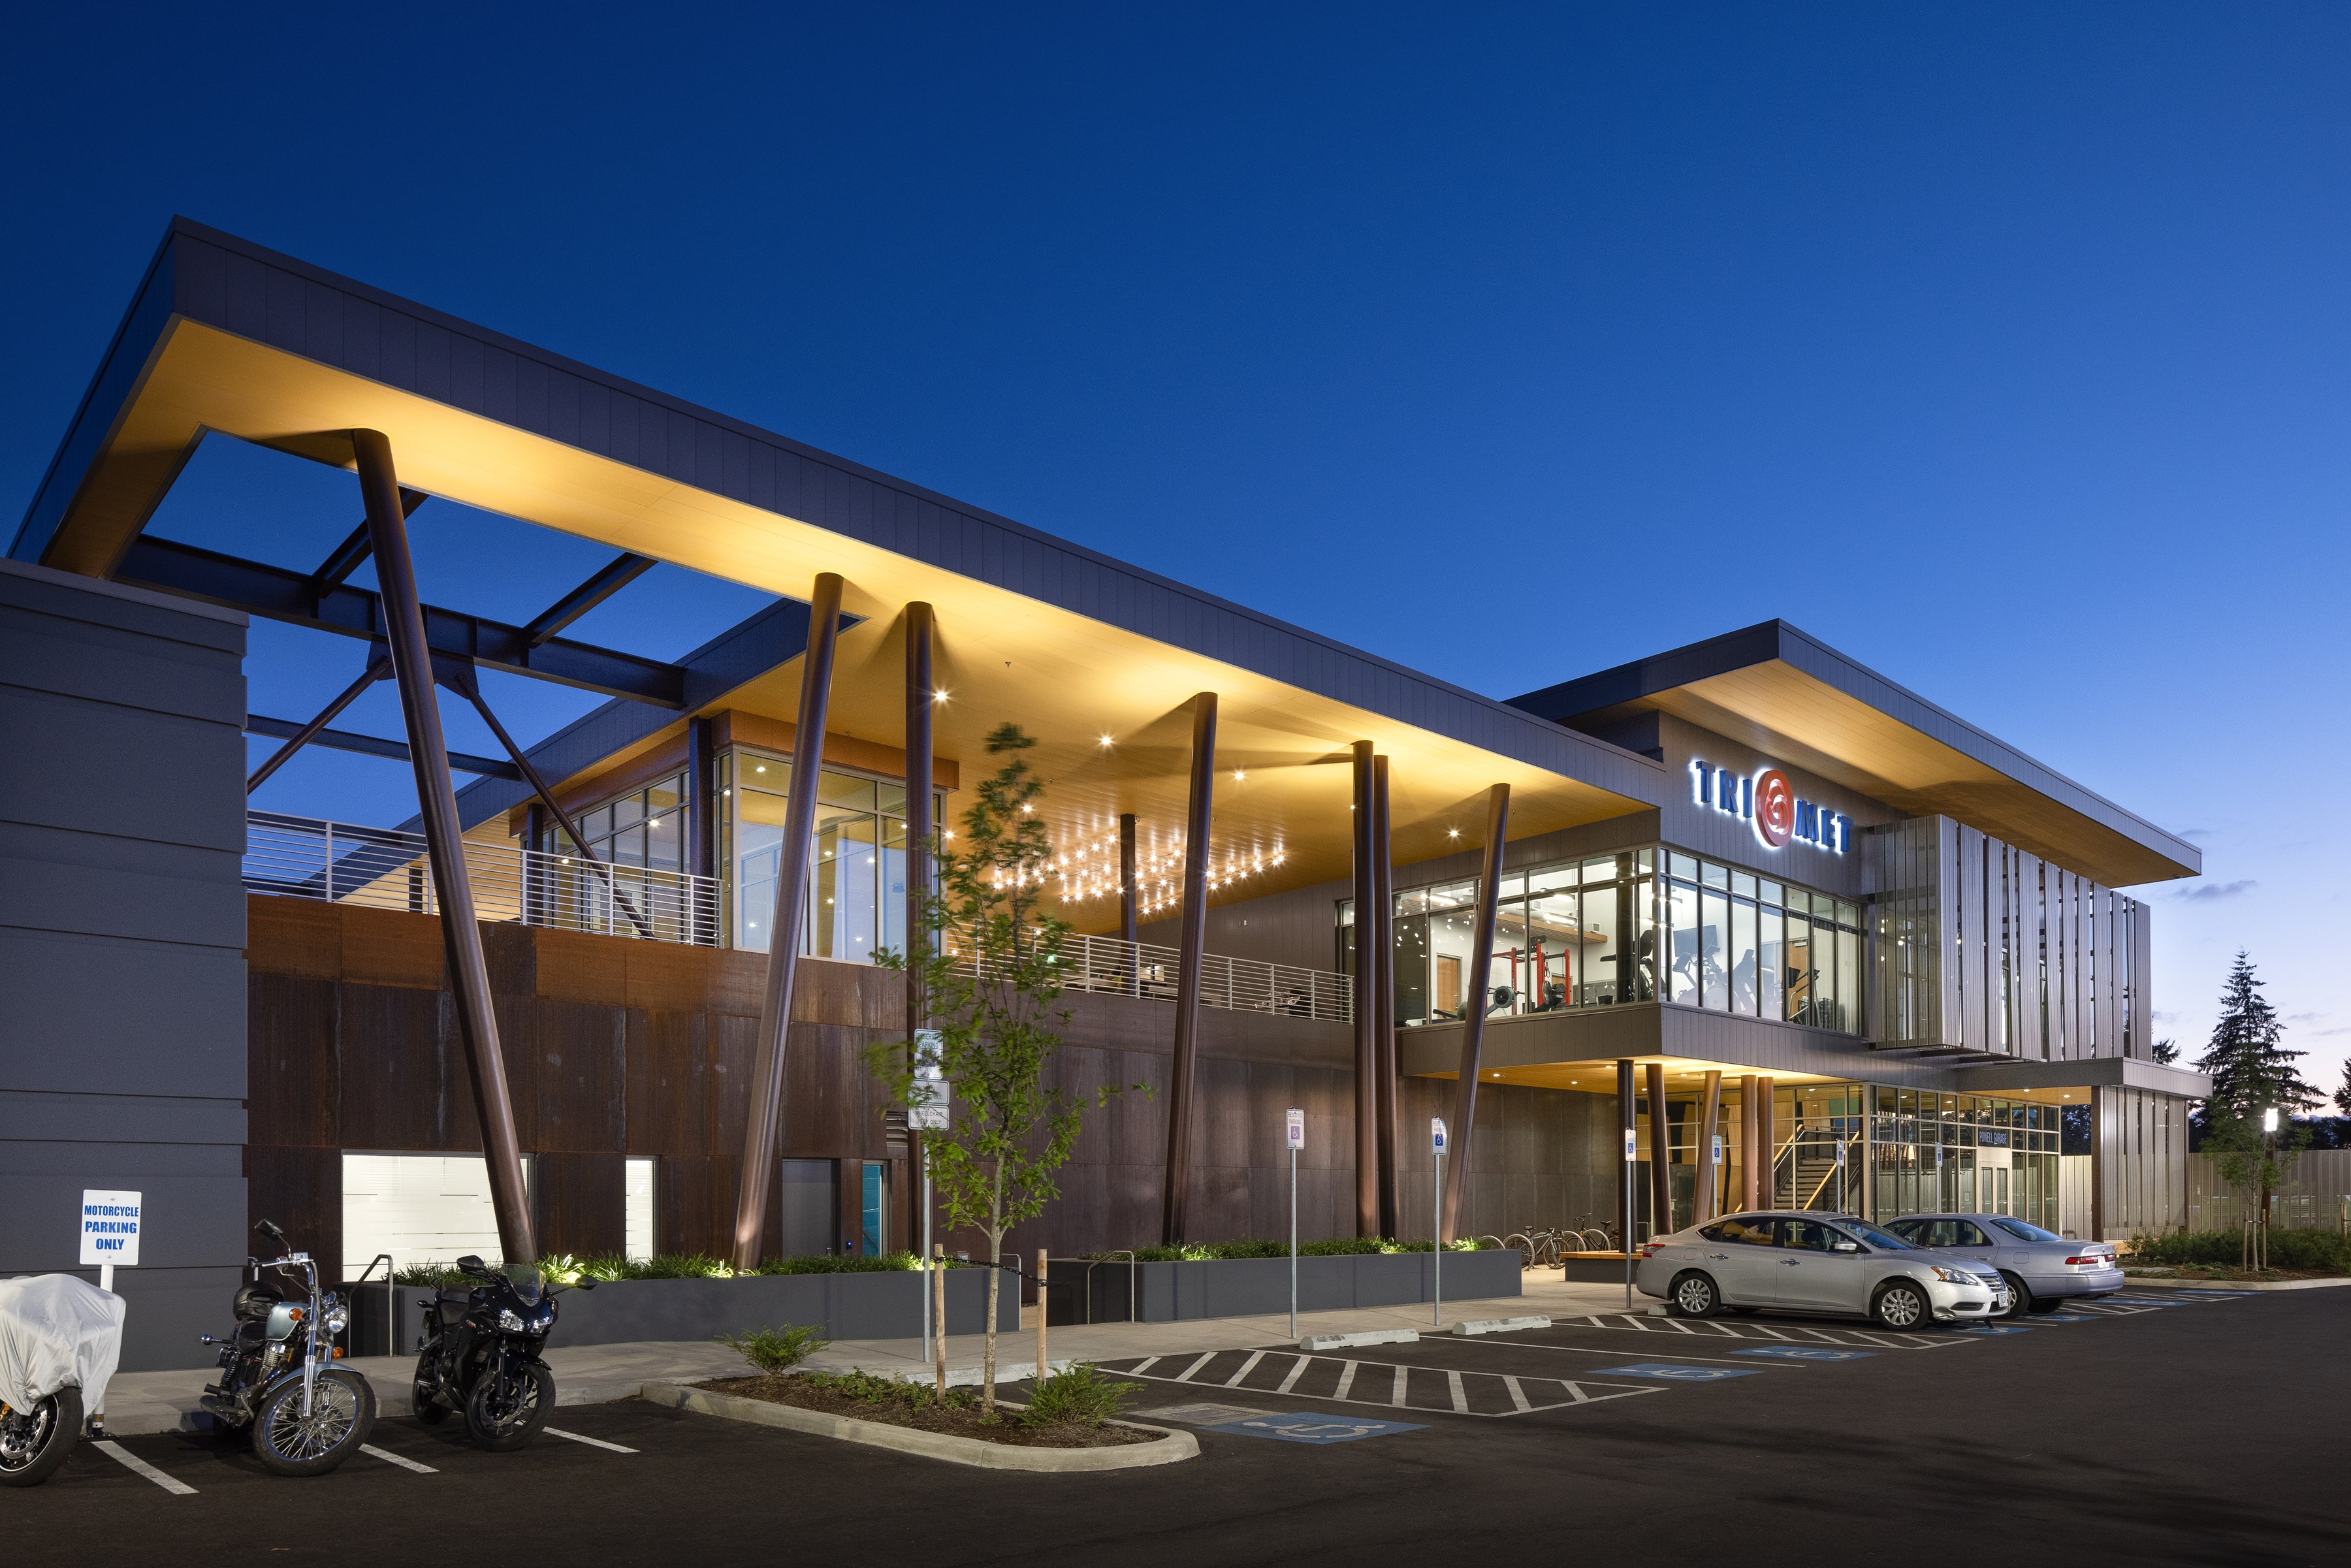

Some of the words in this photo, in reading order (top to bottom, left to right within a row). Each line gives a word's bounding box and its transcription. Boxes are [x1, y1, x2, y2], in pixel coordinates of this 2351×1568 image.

[1795, 799, 1853, 852] MET
[919, 1041, 938, 1049] PARKING
[1979, 1131, 1993, 1143] POWELL
[1993, 1132, 2007, 1144] GARAGE
[84, 1205, 138, 1217] MOTORCYCLE
[85, 1221, 136, 1234] PARKING
[95, 1238, 125, 1250] ONLY
